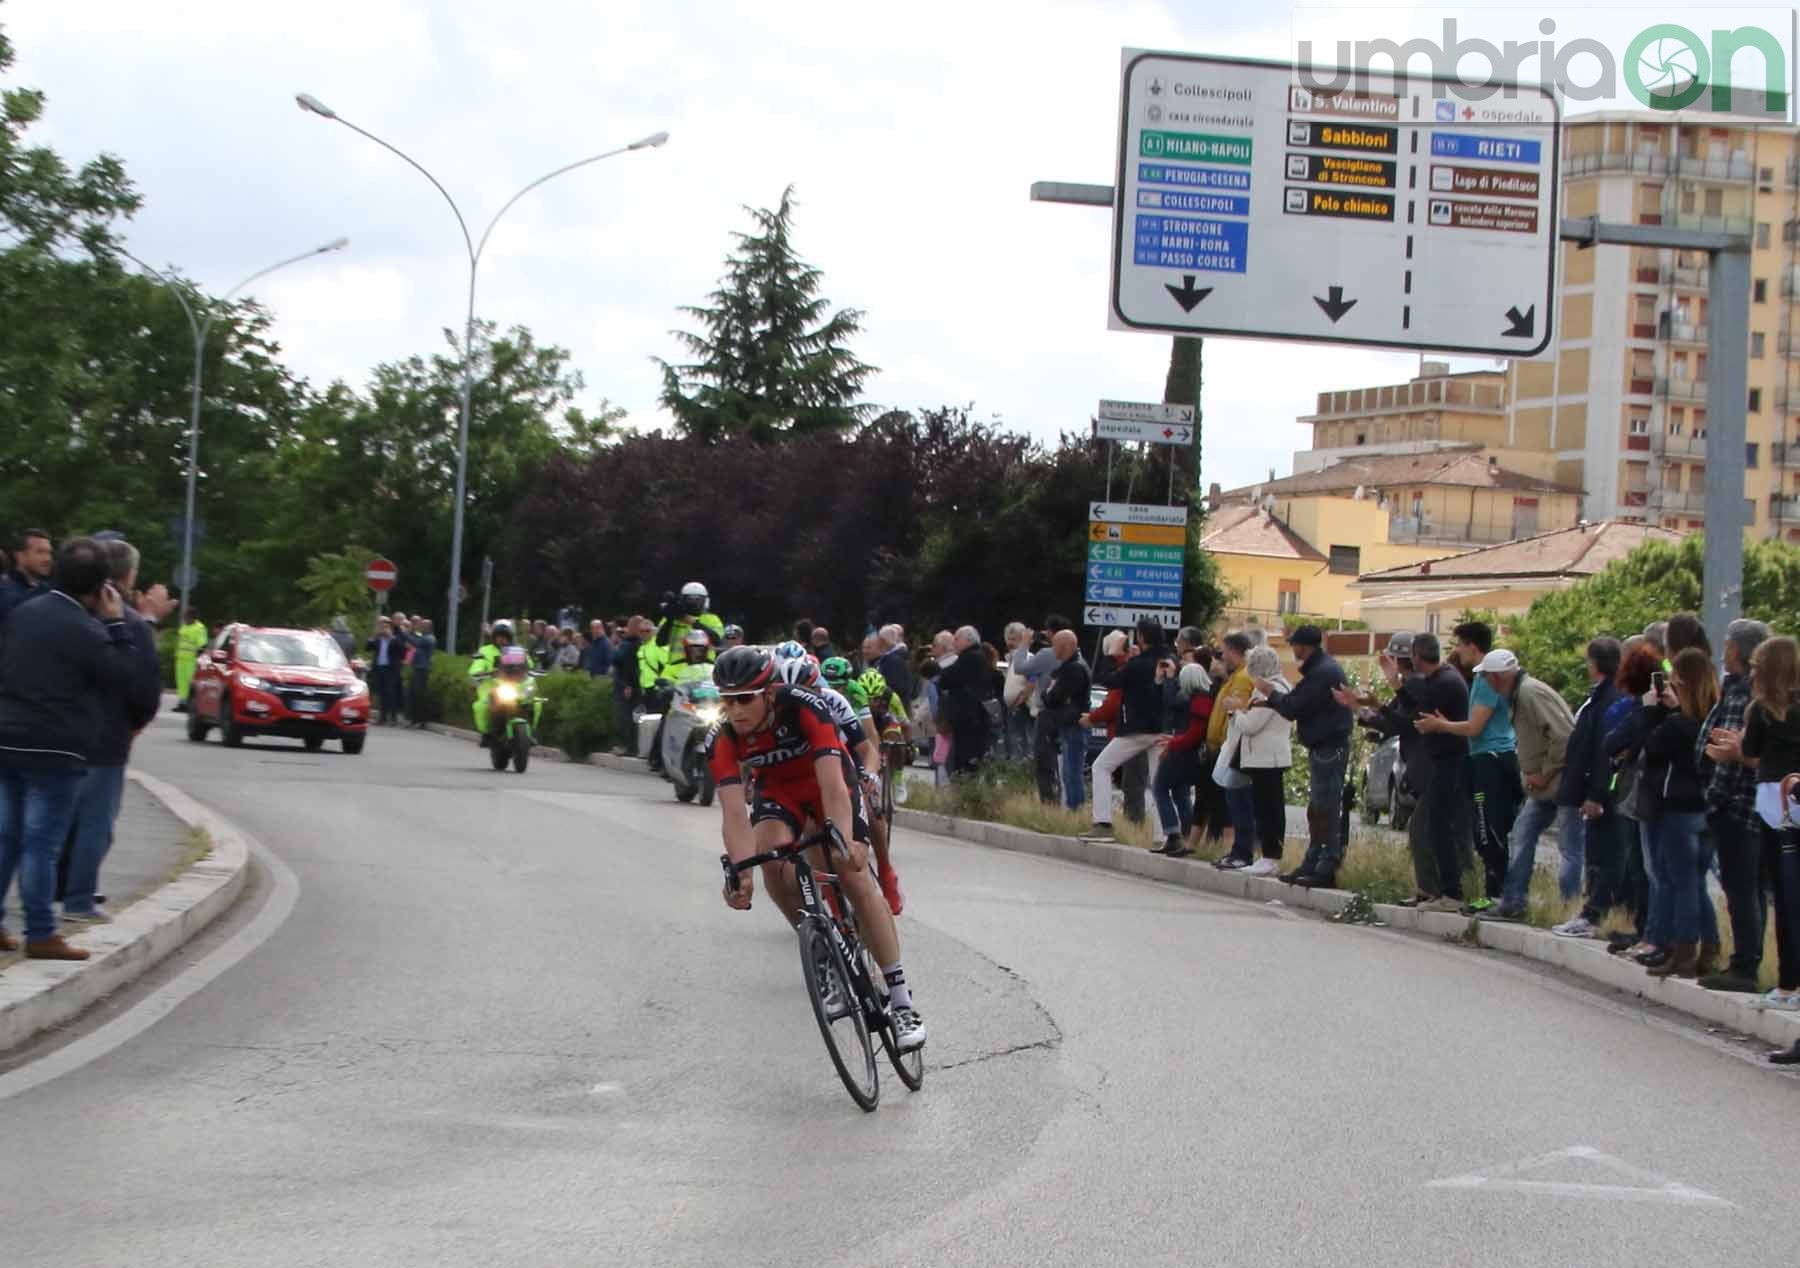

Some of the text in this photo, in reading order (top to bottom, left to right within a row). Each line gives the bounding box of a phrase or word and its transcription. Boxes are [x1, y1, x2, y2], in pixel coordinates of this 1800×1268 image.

[1174, 82, 1252, 101] Collescipoli
[1314, 95, 1397, 114] S. Valentino
[1481, 109, 1543, 123] ospedale
[1321, 126, 1388, 147] Sabbioni
[1478, 140, 1520, 159] RIETI
[1323, 157, 1383, 173] Vascigliano
[1318, 171, 1387, 187] di Stroncone
[1455, 173, 1477, 190] Lago
[1480, 175, 1489, 188] di
[1164, 194, 1234, 212] COLLESCIPOLI
[1314, 194, 1389, 216] Polo chimico
[1162, 219, 1224, 237] STRONCONE
[1160, 251, 1193, 266] PASSO
[1197, 255, 1237, 270] CORESE
